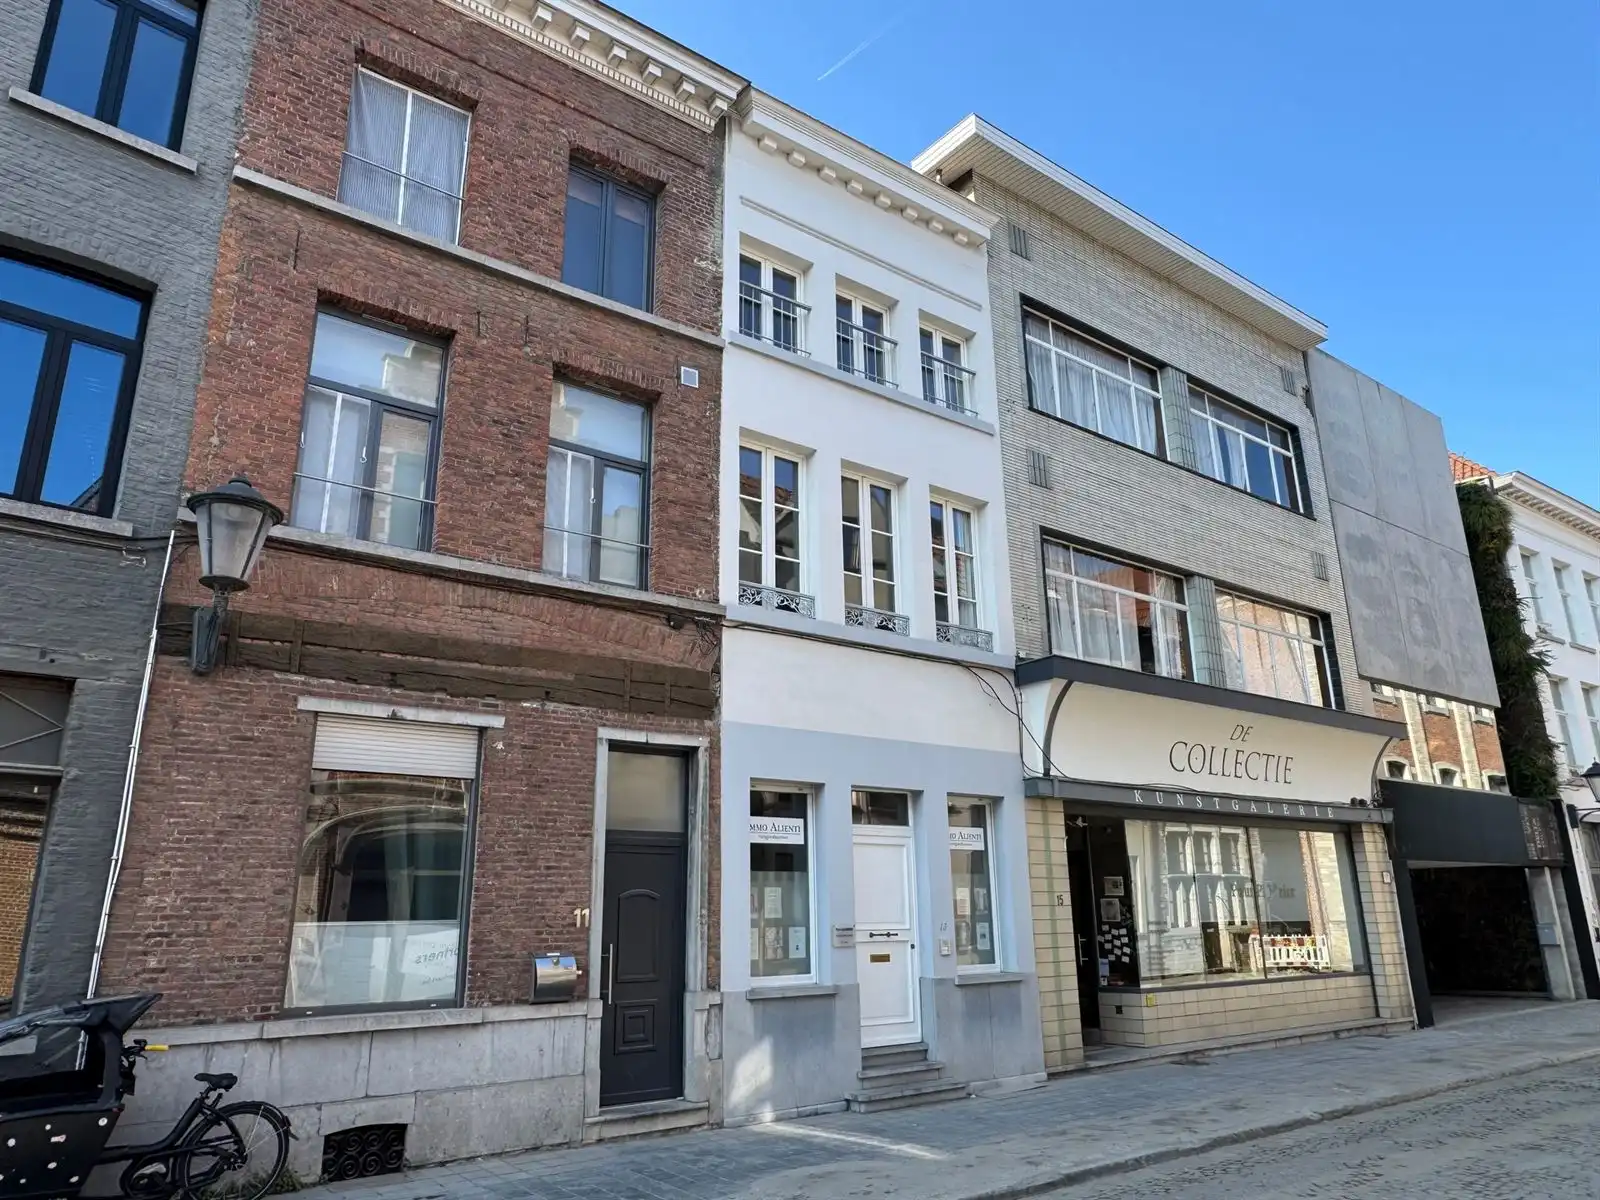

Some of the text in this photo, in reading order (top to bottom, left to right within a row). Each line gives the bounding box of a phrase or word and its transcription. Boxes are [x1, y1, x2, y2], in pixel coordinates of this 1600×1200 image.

[1230, 724, 1254, 742] DE
[1169, 740, 1294, 785] COLLECTIE
[1133, 789, 1334, 818] KUNSTGALERIE
[1056, 894, 1064, 906] 15
[573, 907, 590, 928] 11
